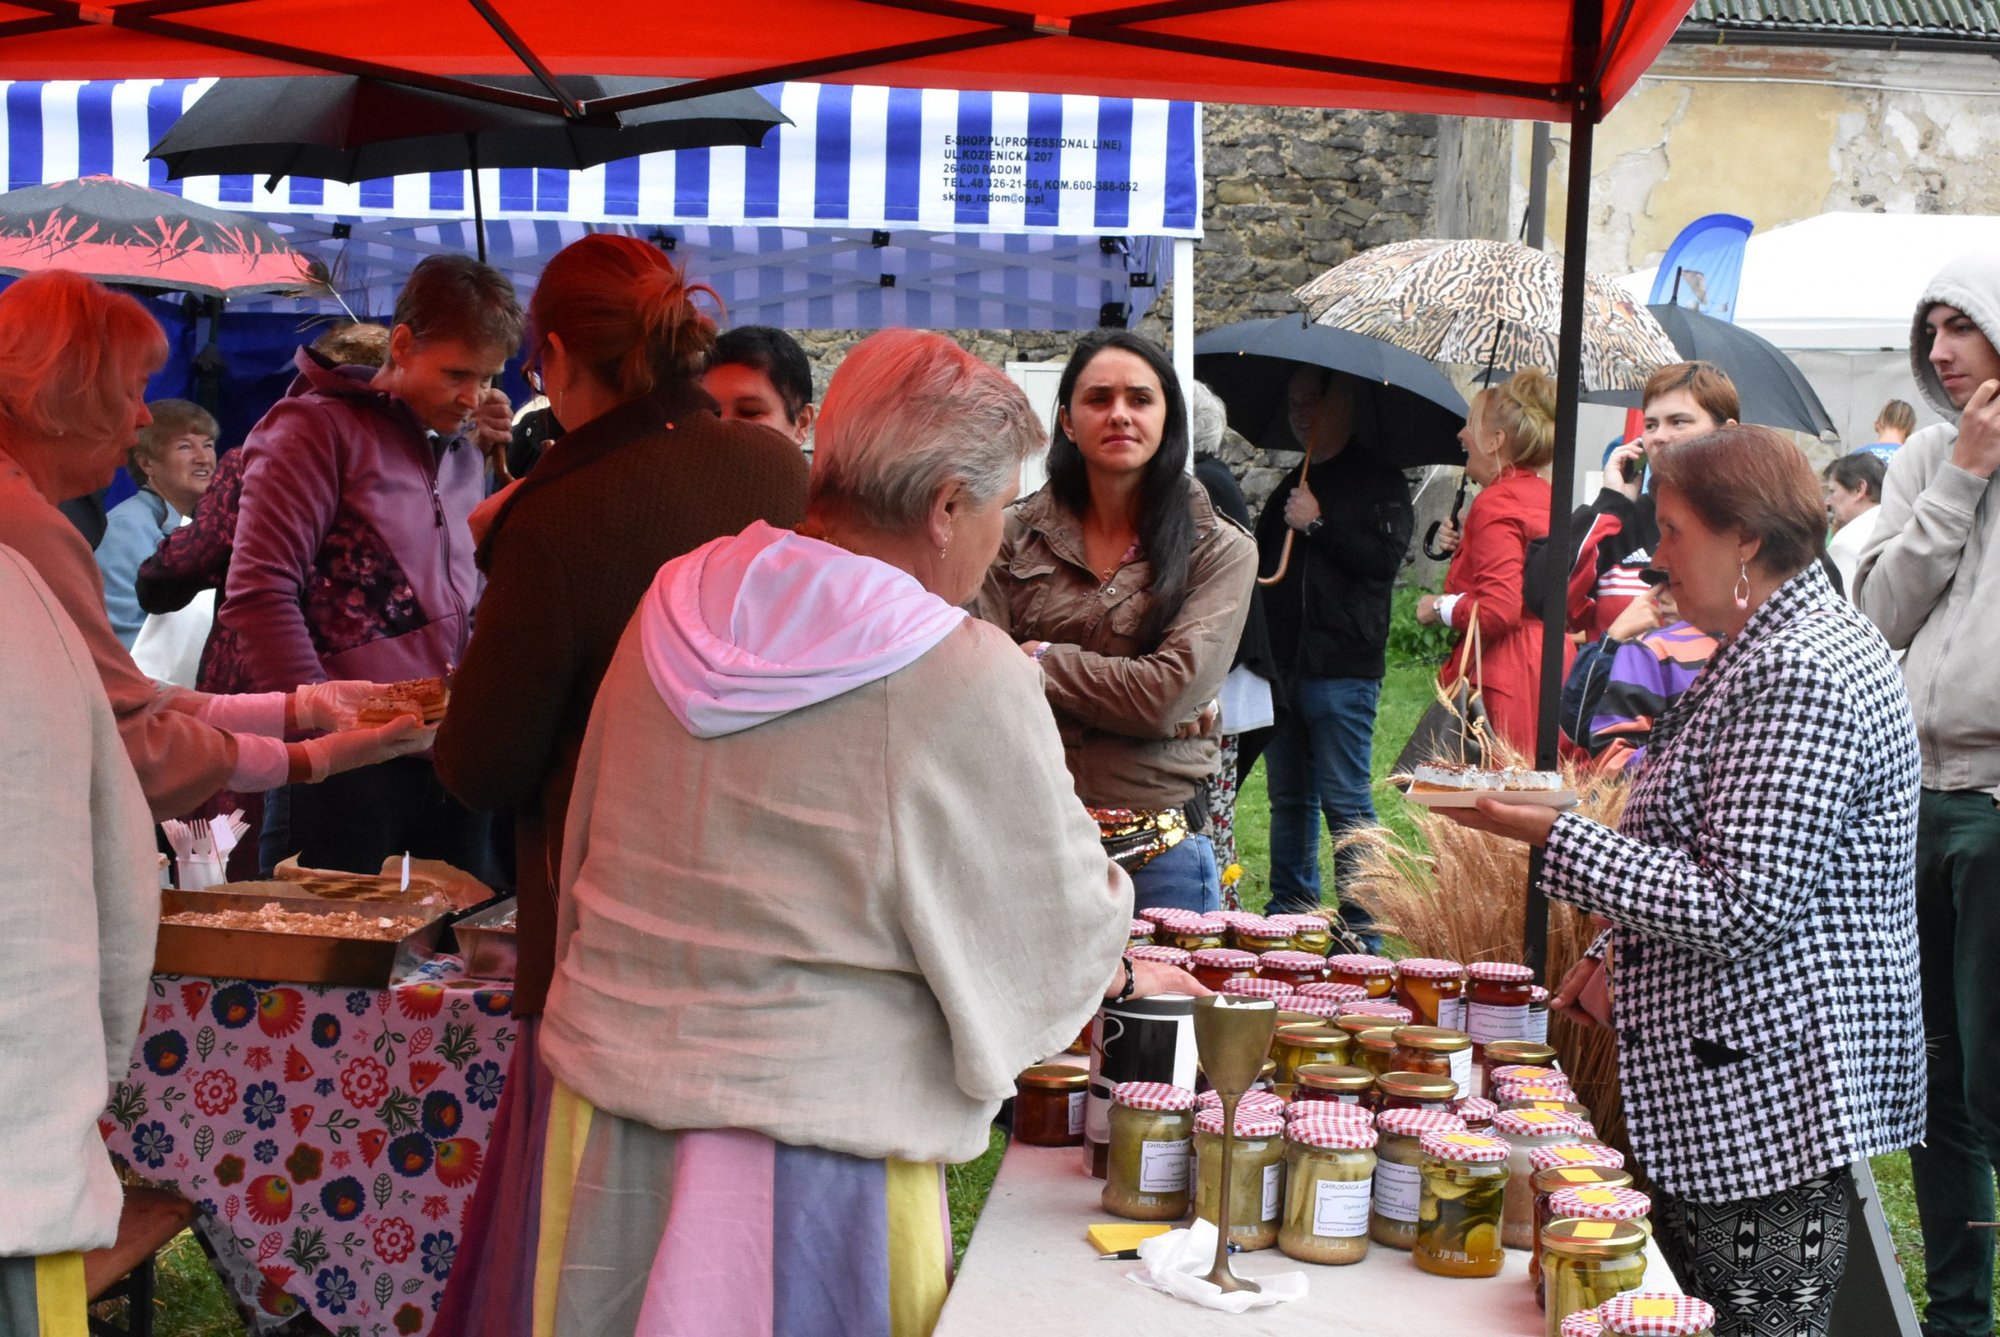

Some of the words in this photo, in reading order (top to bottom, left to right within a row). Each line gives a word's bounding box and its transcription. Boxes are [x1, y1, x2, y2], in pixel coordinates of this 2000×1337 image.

[945, 135, 1089, 149] E-SHOP.PL(PROFESSIONAL
[1093, 139, 1122, 152] LINE)
[944, 149, 1031, 161] UL.KOZIENICKA
[1033, 152, 1053, 162] 207
[943, 164, 980, 174] 26-600
[982, 165, 1022, 175] RADOM
